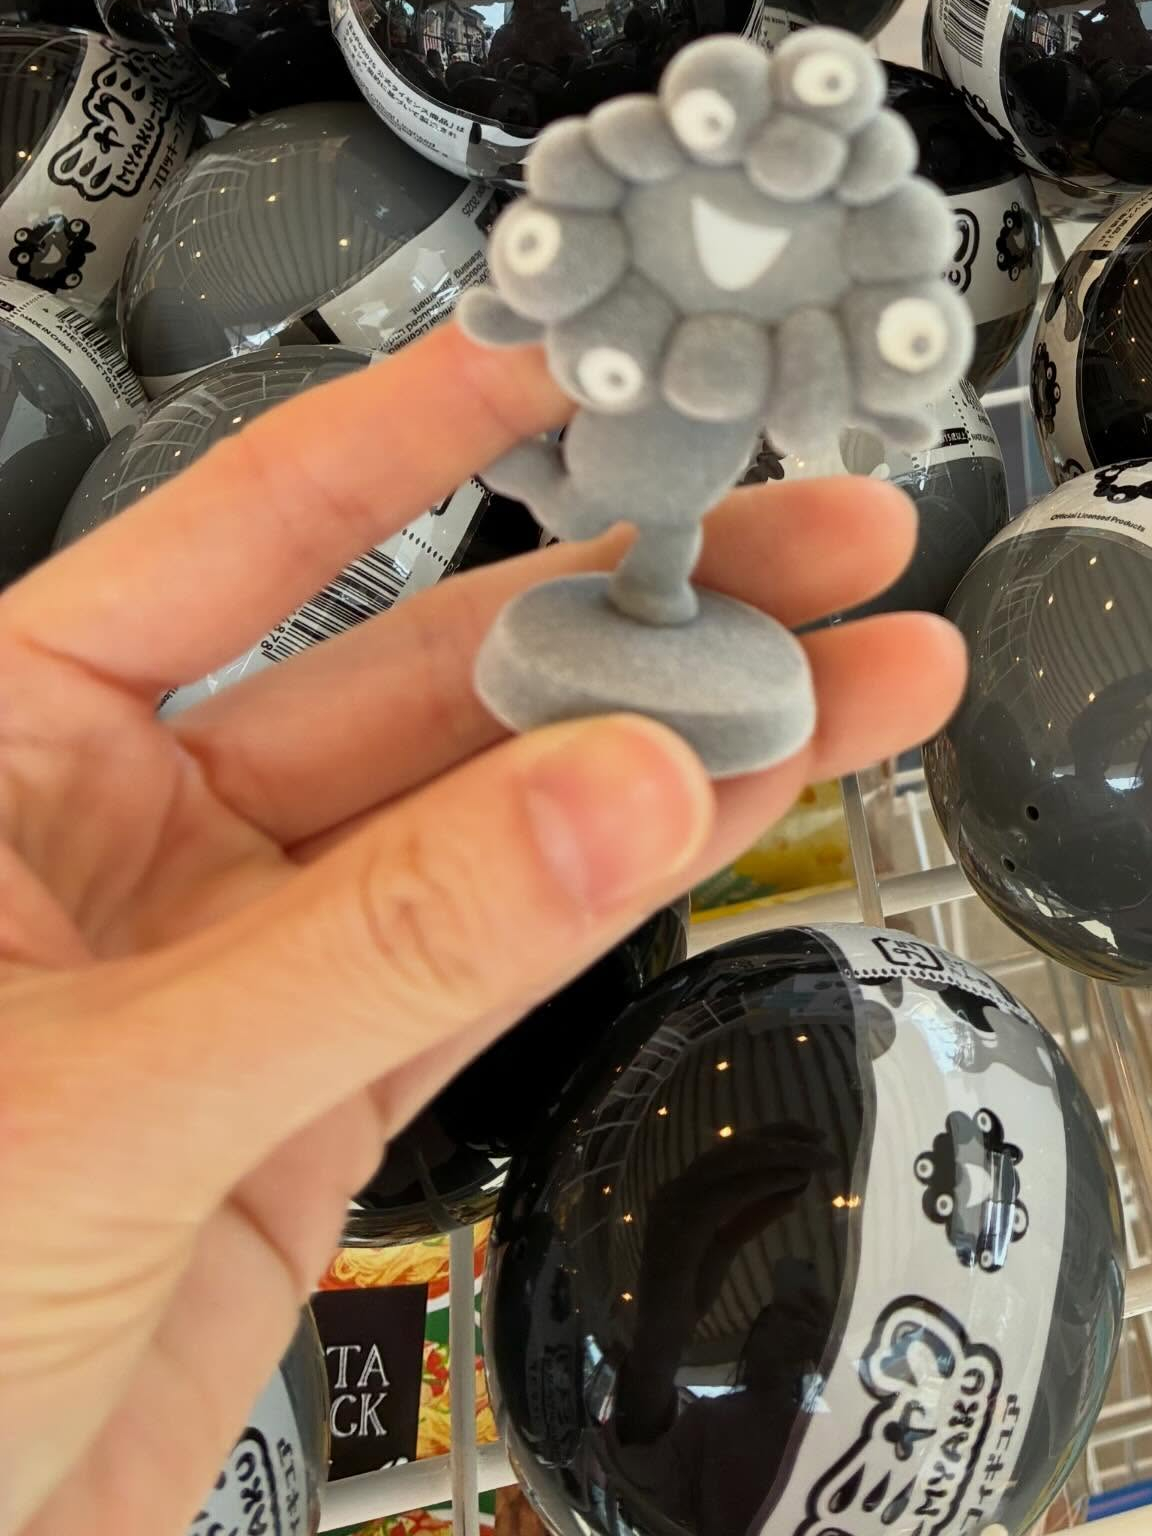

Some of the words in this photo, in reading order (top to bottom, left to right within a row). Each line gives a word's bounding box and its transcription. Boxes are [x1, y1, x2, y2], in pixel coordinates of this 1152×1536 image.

[1050, 512, 1077, 522] Official
[1077, 512, 1111, 523] Licensed
[1110, 515, 1147, 533] Products
[325, 1343, 391, 1389] TA
[329, 1391, 388, 1439] CK
